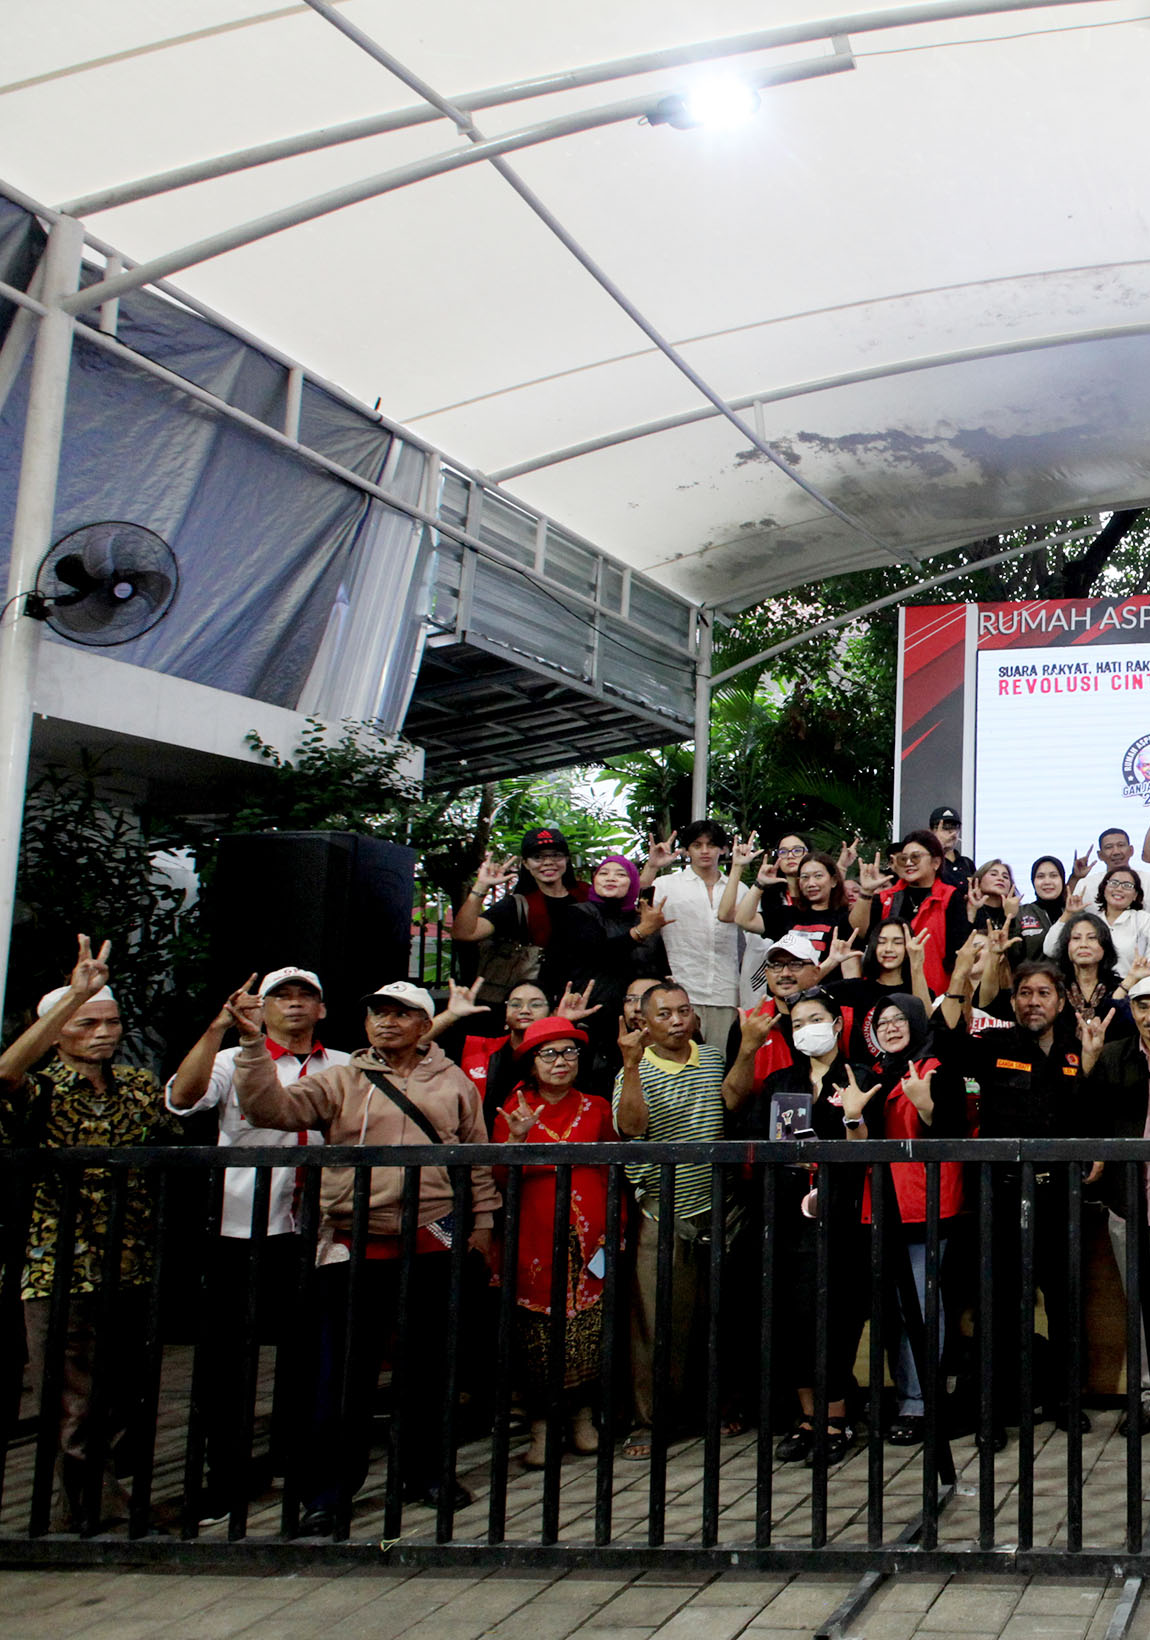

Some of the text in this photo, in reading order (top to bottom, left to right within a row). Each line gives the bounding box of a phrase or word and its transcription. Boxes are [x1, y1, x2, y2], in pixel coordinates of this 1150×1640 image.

[979, 609, 1092, 637] RUMAH
[999, 665, 1037, 678] SUARA
[1096, 661, 1122, 674] HATI
[999, 676, 1099, 696] REVOLUSI
[1124, 747, 1138, 771] RUMAH
[971, 1017, 1010, 1031] ELAJAR
